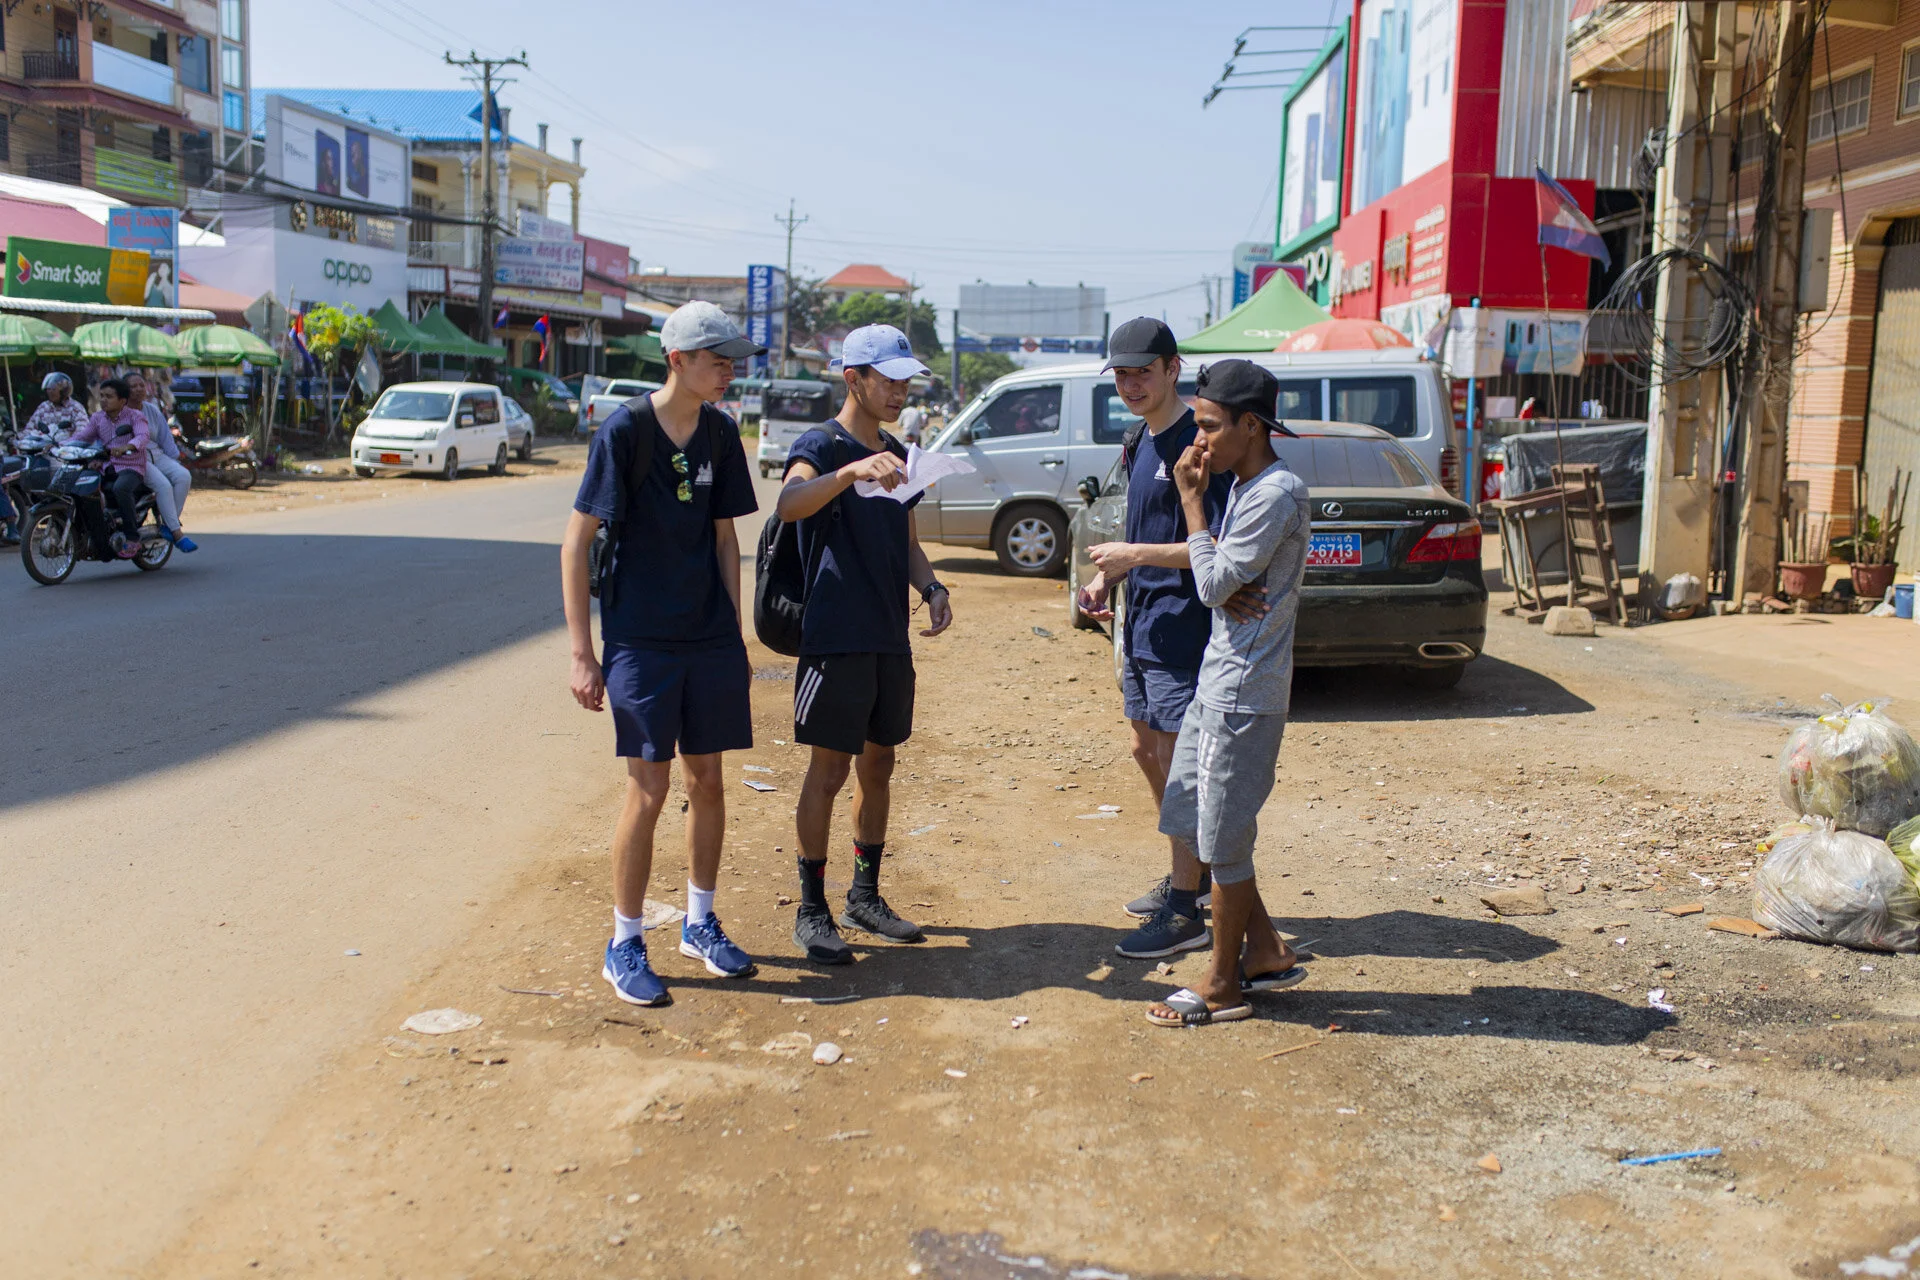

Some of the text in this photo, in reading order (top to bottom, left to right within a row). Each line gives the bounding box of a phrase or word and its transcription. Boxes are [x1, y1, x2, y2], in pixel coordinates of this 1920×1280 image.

[32, 260, 71, 284] Smart
[73, 263, 102, 288] Spot
[1243, 328, 1296, 339] op
[1306, 543, 1353, 558] 2-6713
